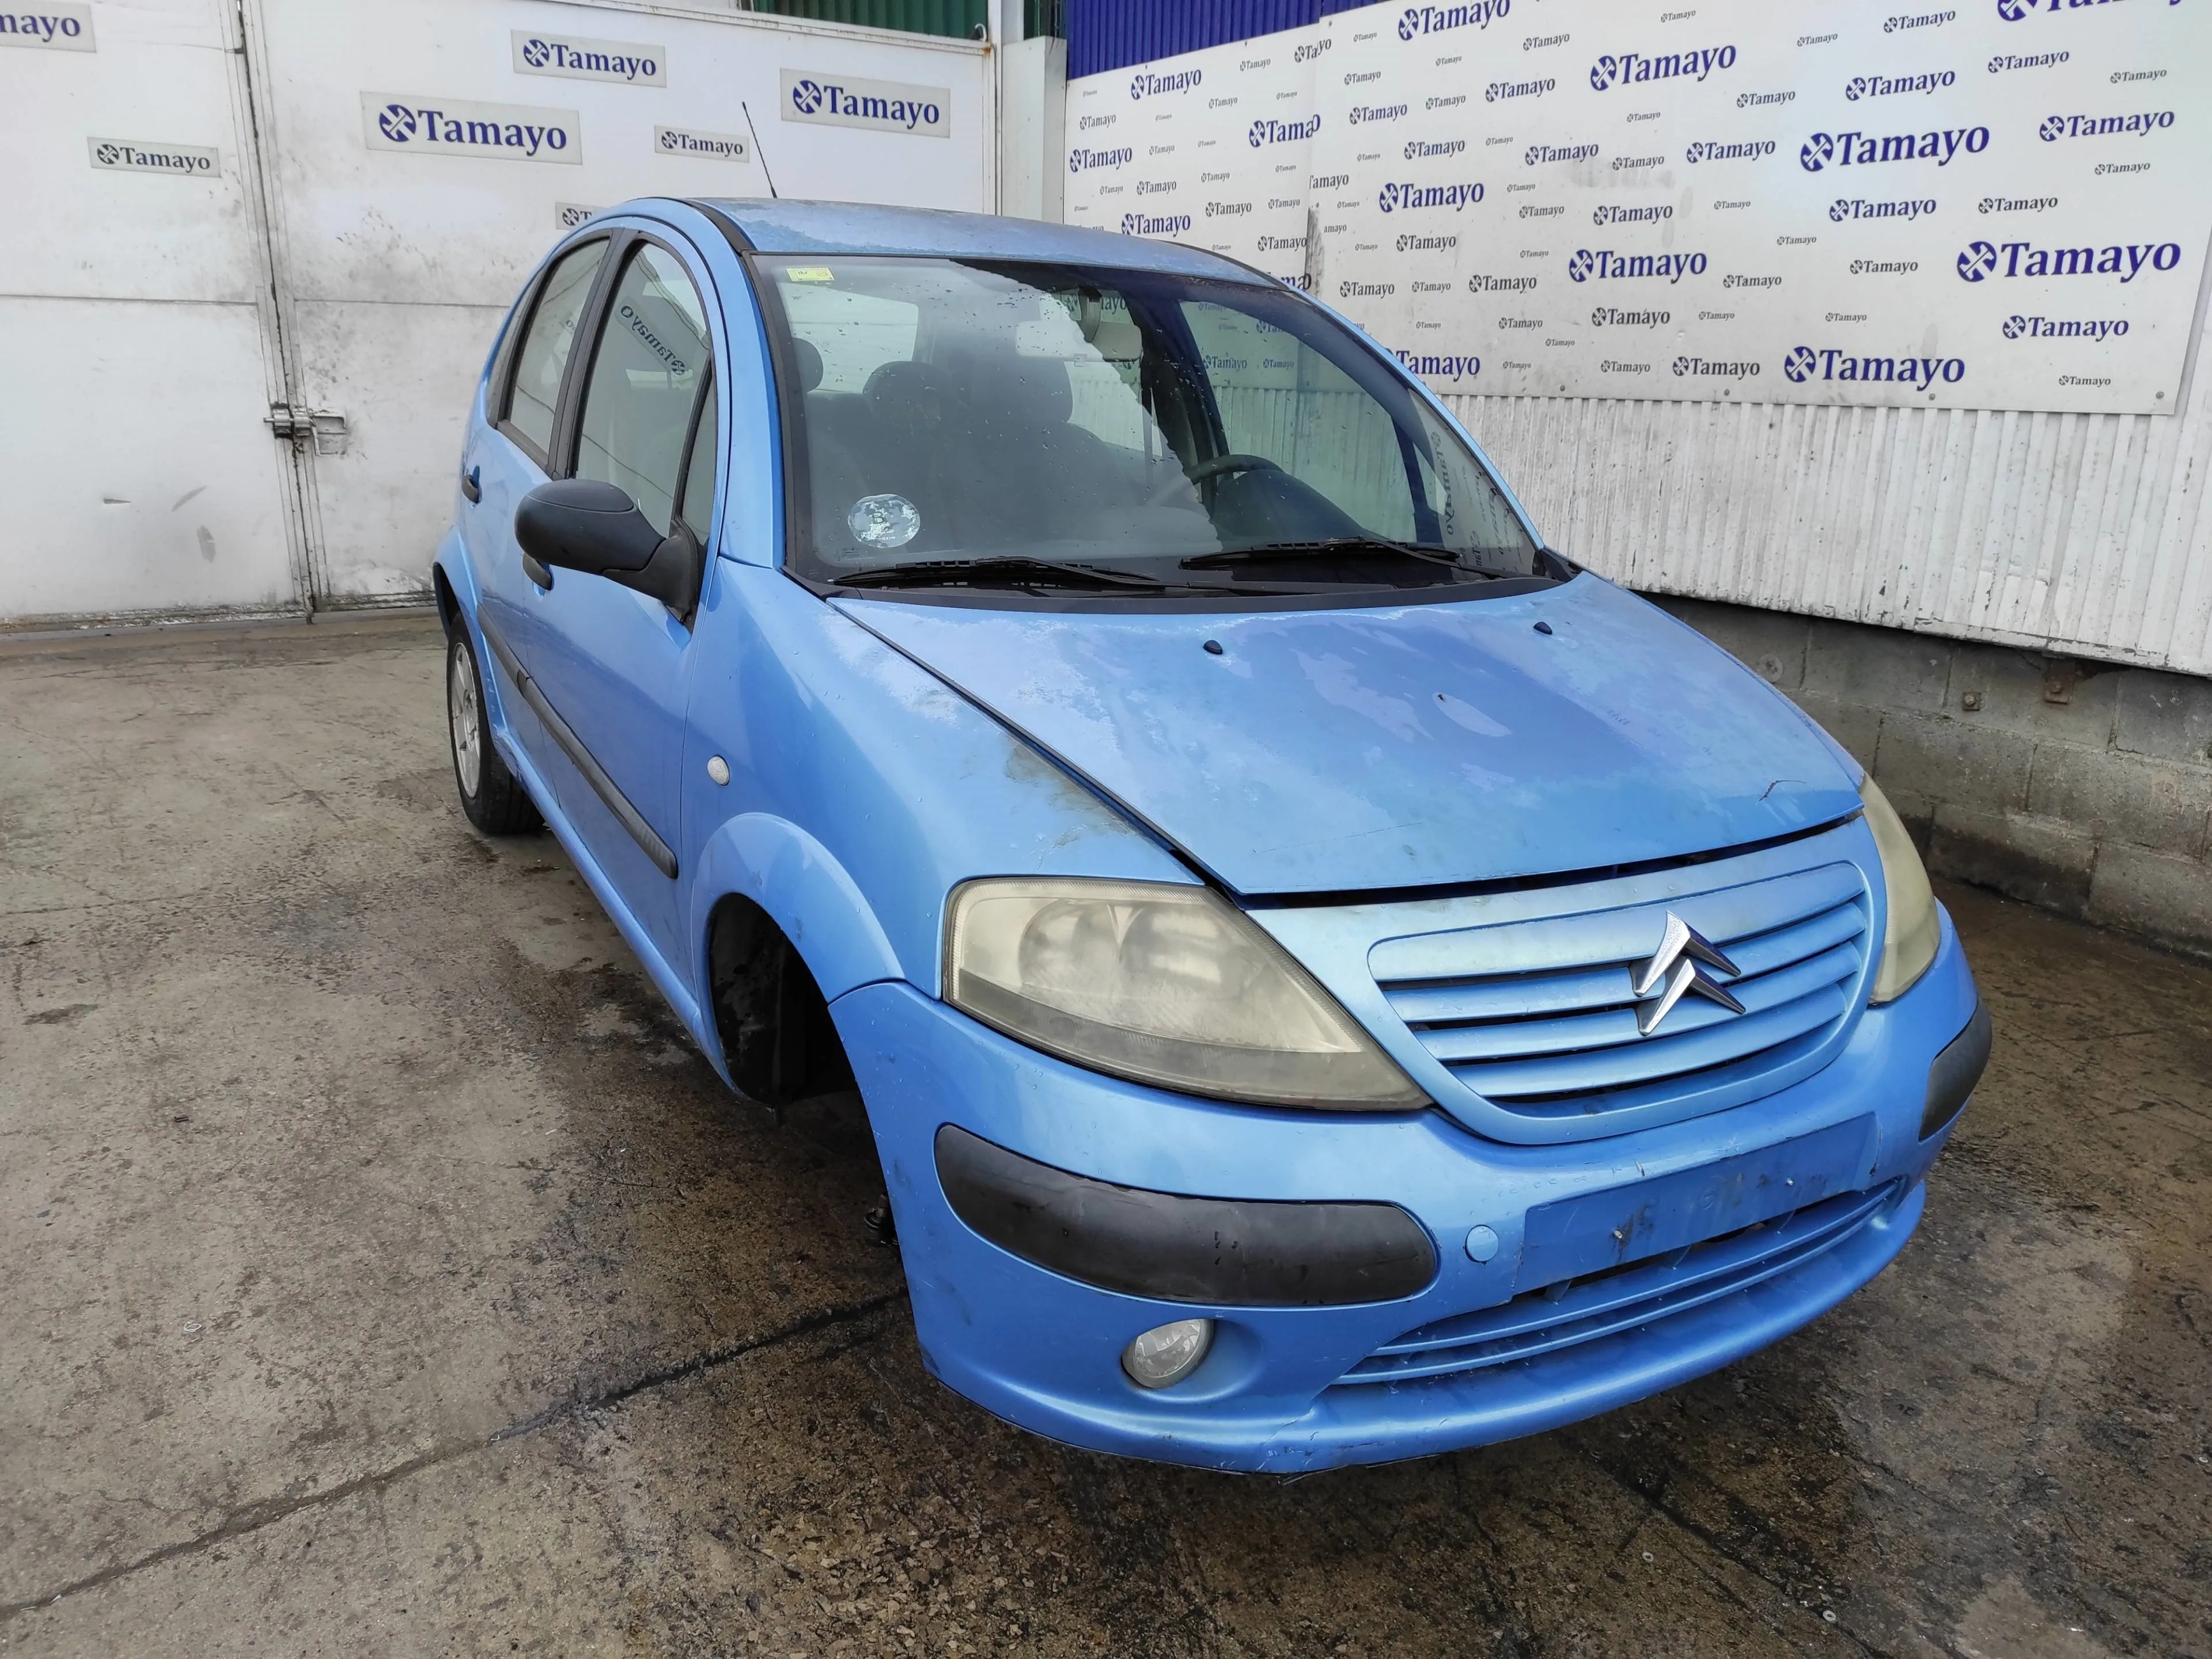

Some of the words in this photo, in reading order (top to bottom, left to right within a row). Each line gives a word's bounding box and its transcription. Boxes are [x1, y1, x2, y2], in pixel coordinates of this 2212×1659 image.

[1420, 0, 1510, 35] Tamayo
[1666, 9, 1696, 21] Tamayo
[1898, 10, 1956, 30] Tamayo
[1532, 33, 1570, 48] Tamayo
[1805, 33, 1838, 45] Tamayo
[550, 43, 657, 81] Tamayo
[1619, 45, 1736, 85] Tamayo
[2004, 51, 2070, 70] Tamayo
[1145, 69, 1202, 96] Tamayo
[1351, 71, 1381, 84] Tamayo
[1868, 71, 1956, 97] Tamayo
[2122, 70, 2167, 82] Tamayo
[1497, 78, 1556, 100] Tamayo
[823, 85, 940, 130] Tamayo
[1433, 95, 1466, 108] Tamayo
[1749, 91, 1796, 106] Tamayo
[1086, 114, 1116, 128] Tamayo
[1361, 104, 1407, 122] Tamayo
[1633, 112, 1661, 122] Tamayo
[417, 109, 567, 157] Tamayo
[2067, 111, 2175, 137] Tamayo
[677, 134, 743, 158] Tamayo
[1416, 140, 1465, 158] Tamayo
[1540, 144, 1599, 163] Tamayo
[1705, 141, 1776, 161] Tamayo
[1836, 126, 1990, 166] Tamayo
[119, 147, 210, 173] Tamayo
[1081, 147, 1132, 170] Tamayo
[1623, 154, 1665, 171] Tamayo
[2105, 162, 2150, 173] Tamayo
[1144, 181, 1177, 195] Tamayo
[1400, 183, 1484, 212] Tamayo
[1720, 199, 1751, 211] Tamayo
[1995, 198, 2058, 213] Tamayo
[1214, 202, 1252, 217] Tamayo
[1528, 204, 1565, 218] Tamayo
[1609, 206, 1673, 225] Tamayo
[1850, 199, 1937, 221] Tamayo
[1135, 214, 1191, 238] Tamayo
[1267, 236, 1307, 252] Tamayo
[1408, 235, 1456, 252] Tamayo
[1785, 236, 1817, 245] Tamayo
[1596, 251, 1707, 285] Tamayo
[1863, 260, 1918, 275] Tamayo
[2001, 242, 2181, 283] Tamayo
[1351, 282, 1395, 299] Tamayo
[1419, 282, 1451, 294] Tamayo
[1482, 275, 1537, 294] Tamayo
[1734, 275, 1782, 289] Tamayo
[1508, 317, 1543, 331] Tamayo
[1705, 310, 1736, 321] Tamayo
[1832, 312, 1868, 323] Tamayo
[2028, 317, 2129, 342] Tamayo
[1212, 356, 1247, 372] Tamayo
[1396, 350, 1480, 382] Tamayo
[1610, 361, 1651, 375] Tamayo
[1690, 358, 1760, 381] Tamayo
[1819, 350, 1965, 392] Tamayo
[2069, 376, 2111, 388] Tamayo
